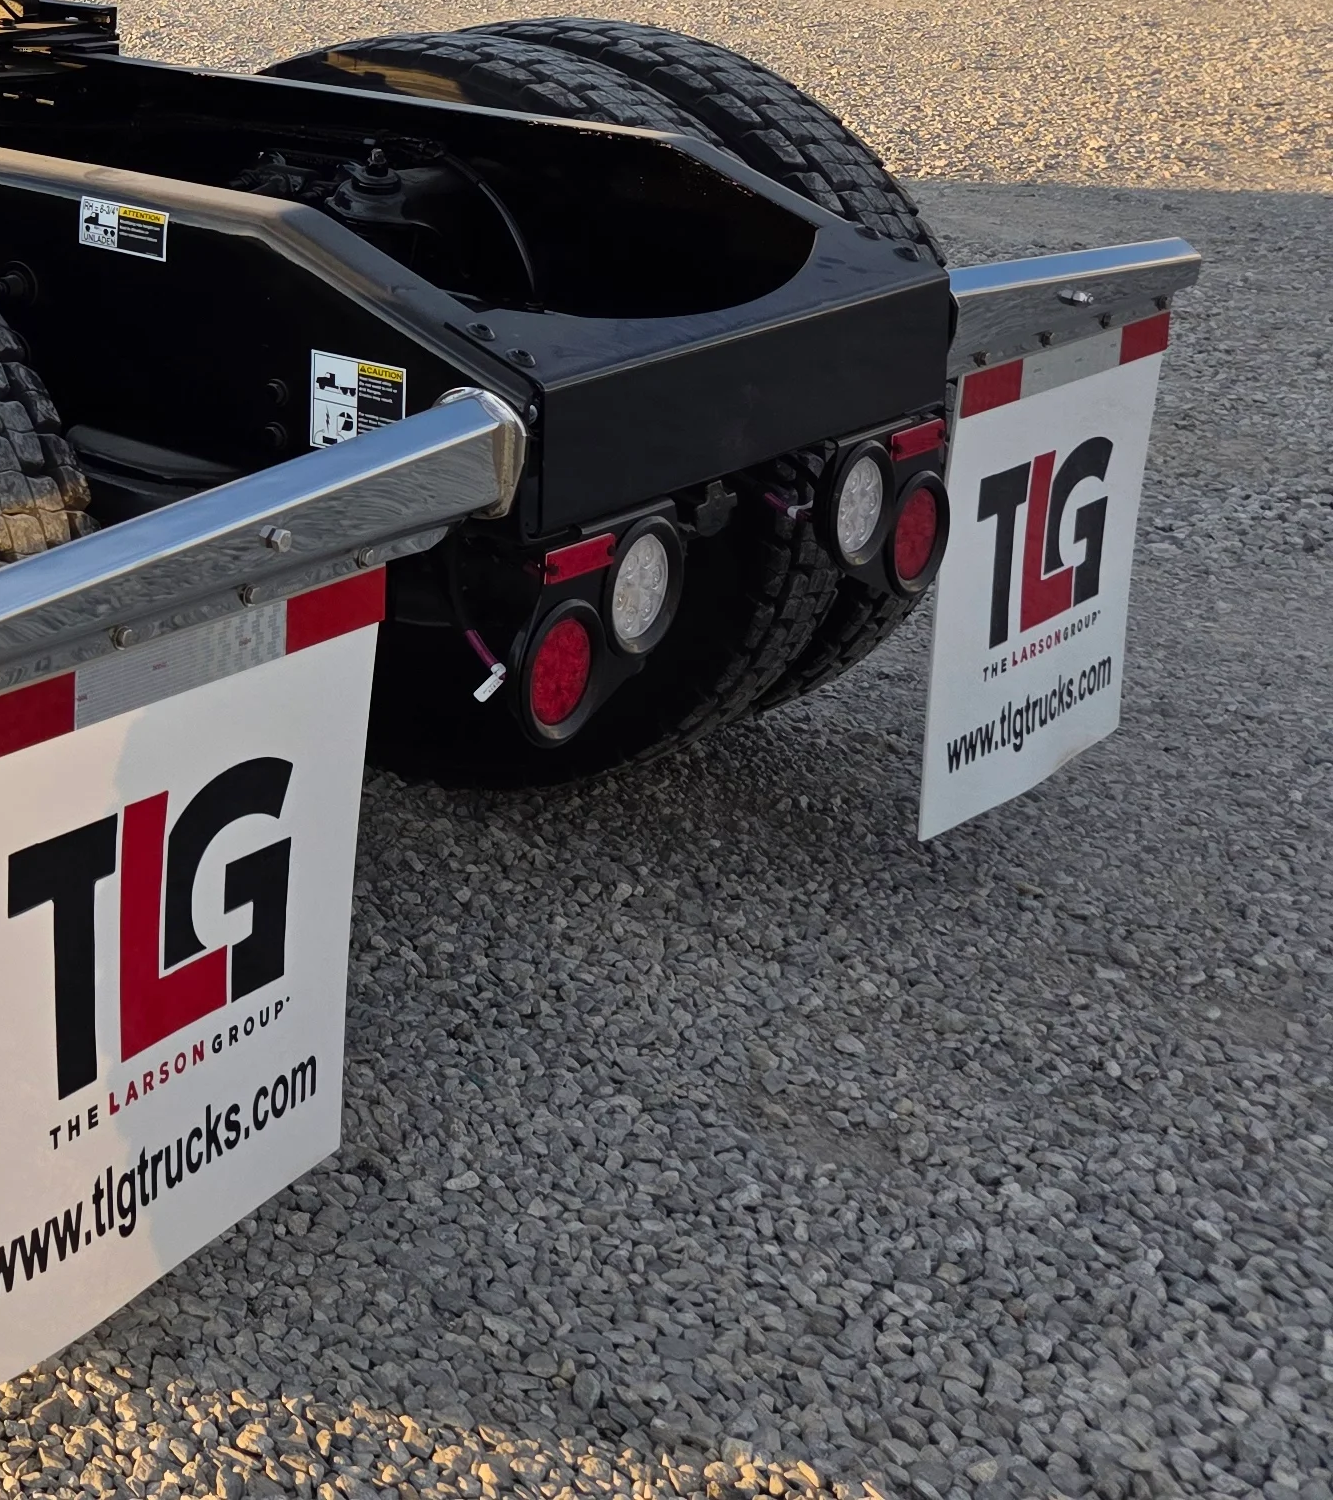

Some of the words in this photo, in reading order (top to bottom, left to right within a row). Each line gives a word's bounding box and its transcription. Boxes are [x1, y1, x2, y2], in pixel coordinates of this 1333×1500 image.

[123, 209, 160, 222] ATTENTION
[83, 233, 116, 246] UNLADEN
[367, 367, 402, 380] CAUTION
[977, 436, 1113, 650] TLG
[983, 657, 1007, 683] THE
[947, 655, 1112, 774] www.tlgtrucks.com
[8, 757, 293, 1100] TLG
[50, 1104, 99, 1151] THE
